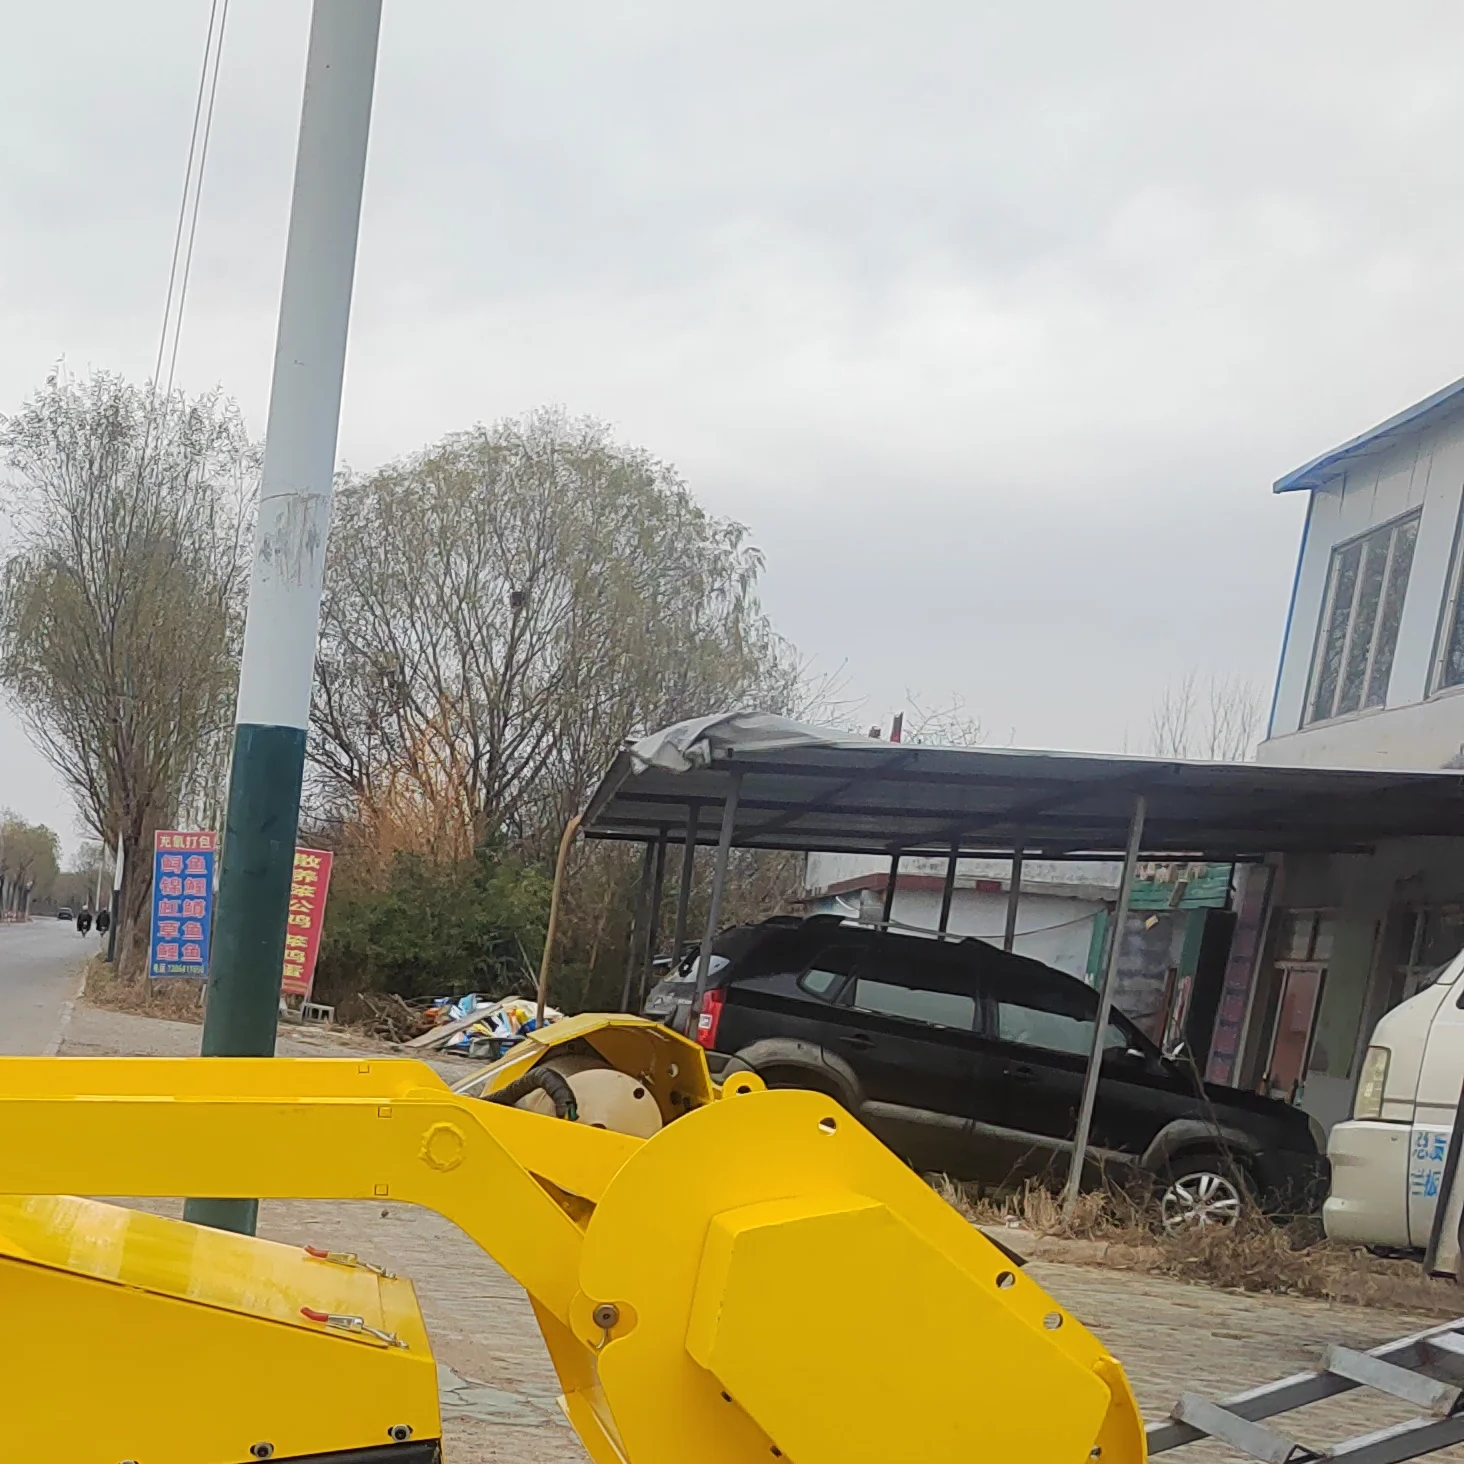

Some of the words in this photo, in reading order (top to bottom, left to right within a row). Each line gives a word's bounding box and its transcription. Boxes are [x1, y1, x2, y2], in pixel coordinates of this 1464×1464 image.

[159, 835, 211, 848] 充氧打包
[157, 921, 203, 940] 草鱼
